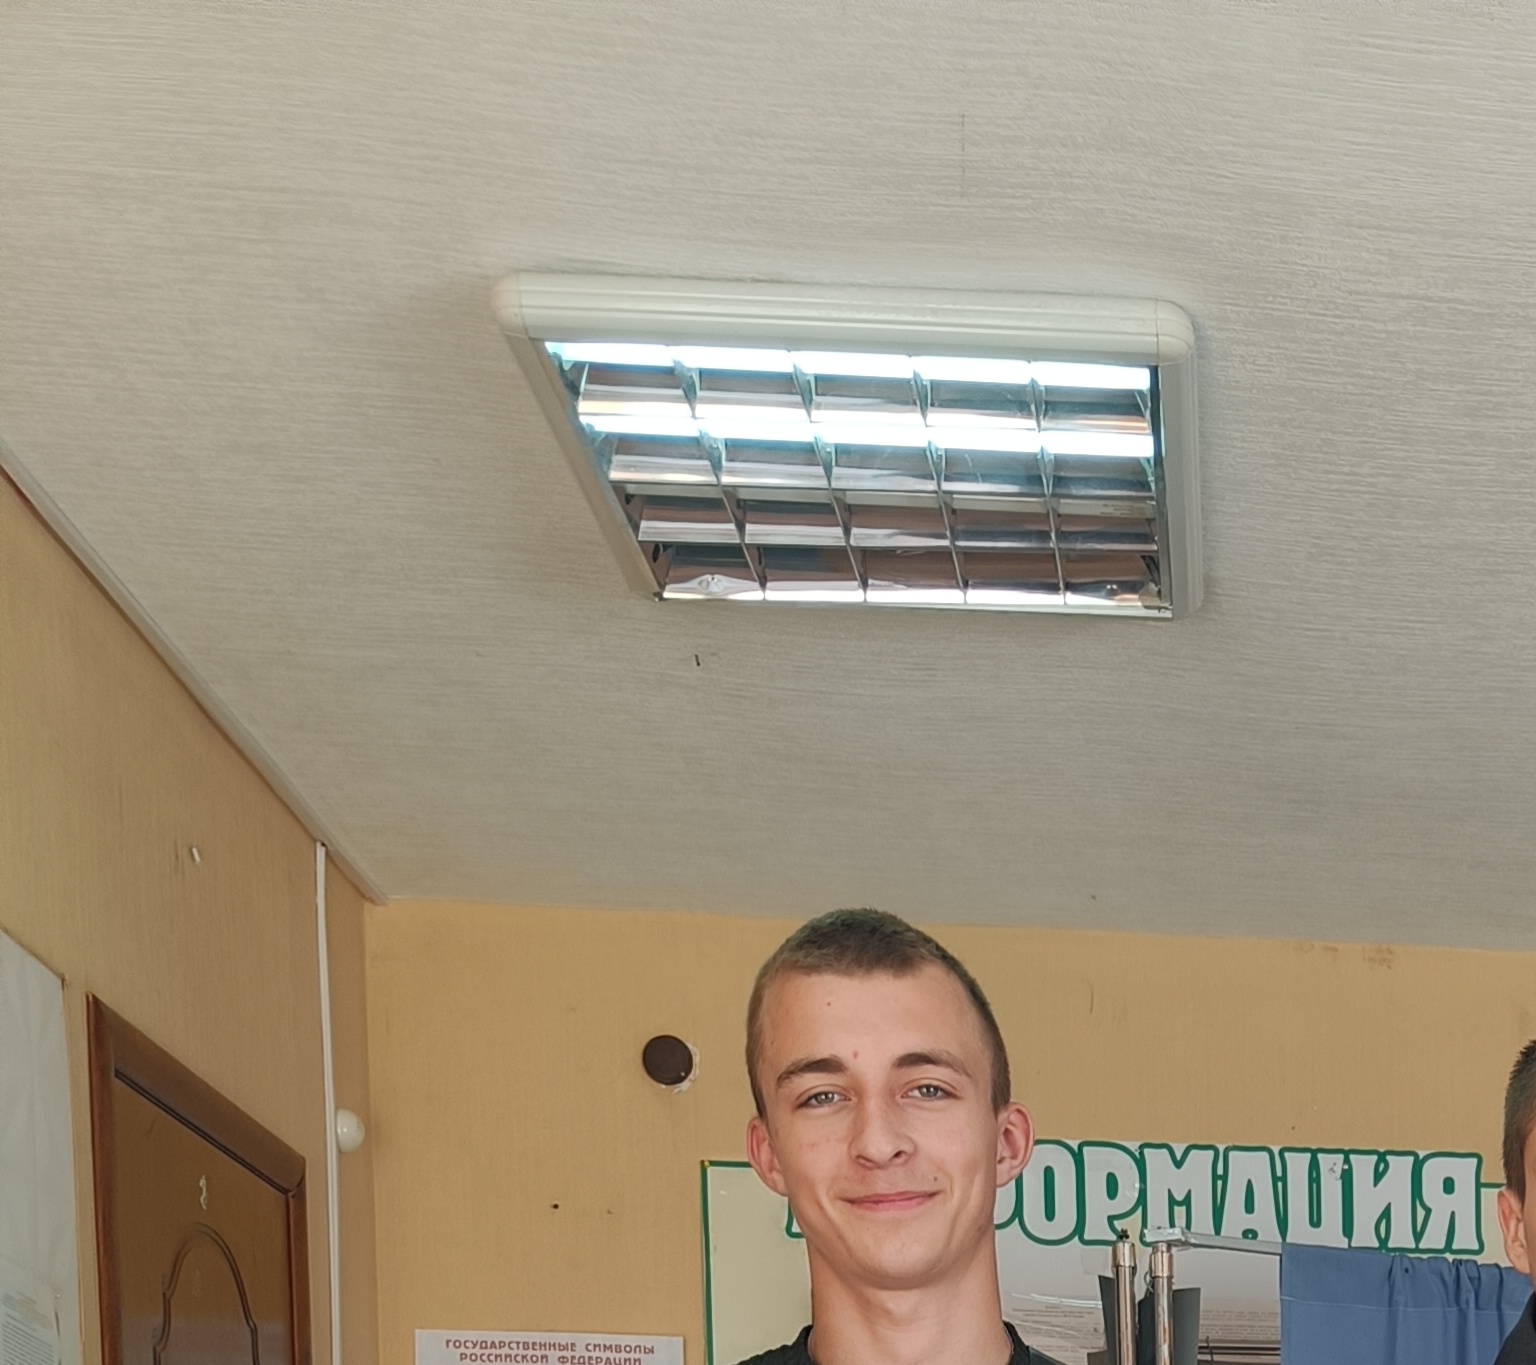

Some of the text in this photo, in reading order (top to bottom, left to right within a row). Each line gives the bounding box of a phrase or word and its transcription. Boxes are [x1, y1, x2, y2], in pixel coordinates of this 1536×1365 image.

[786, 1139, 1484, 1255] ОРМАЦИЯ
[445, 1339, 655, 1355] ГОСУДАРСТВЕННЫЕ СИМВОЛЫ
[459, 1352, 549, 1364] РОССИЙСКОЙ
